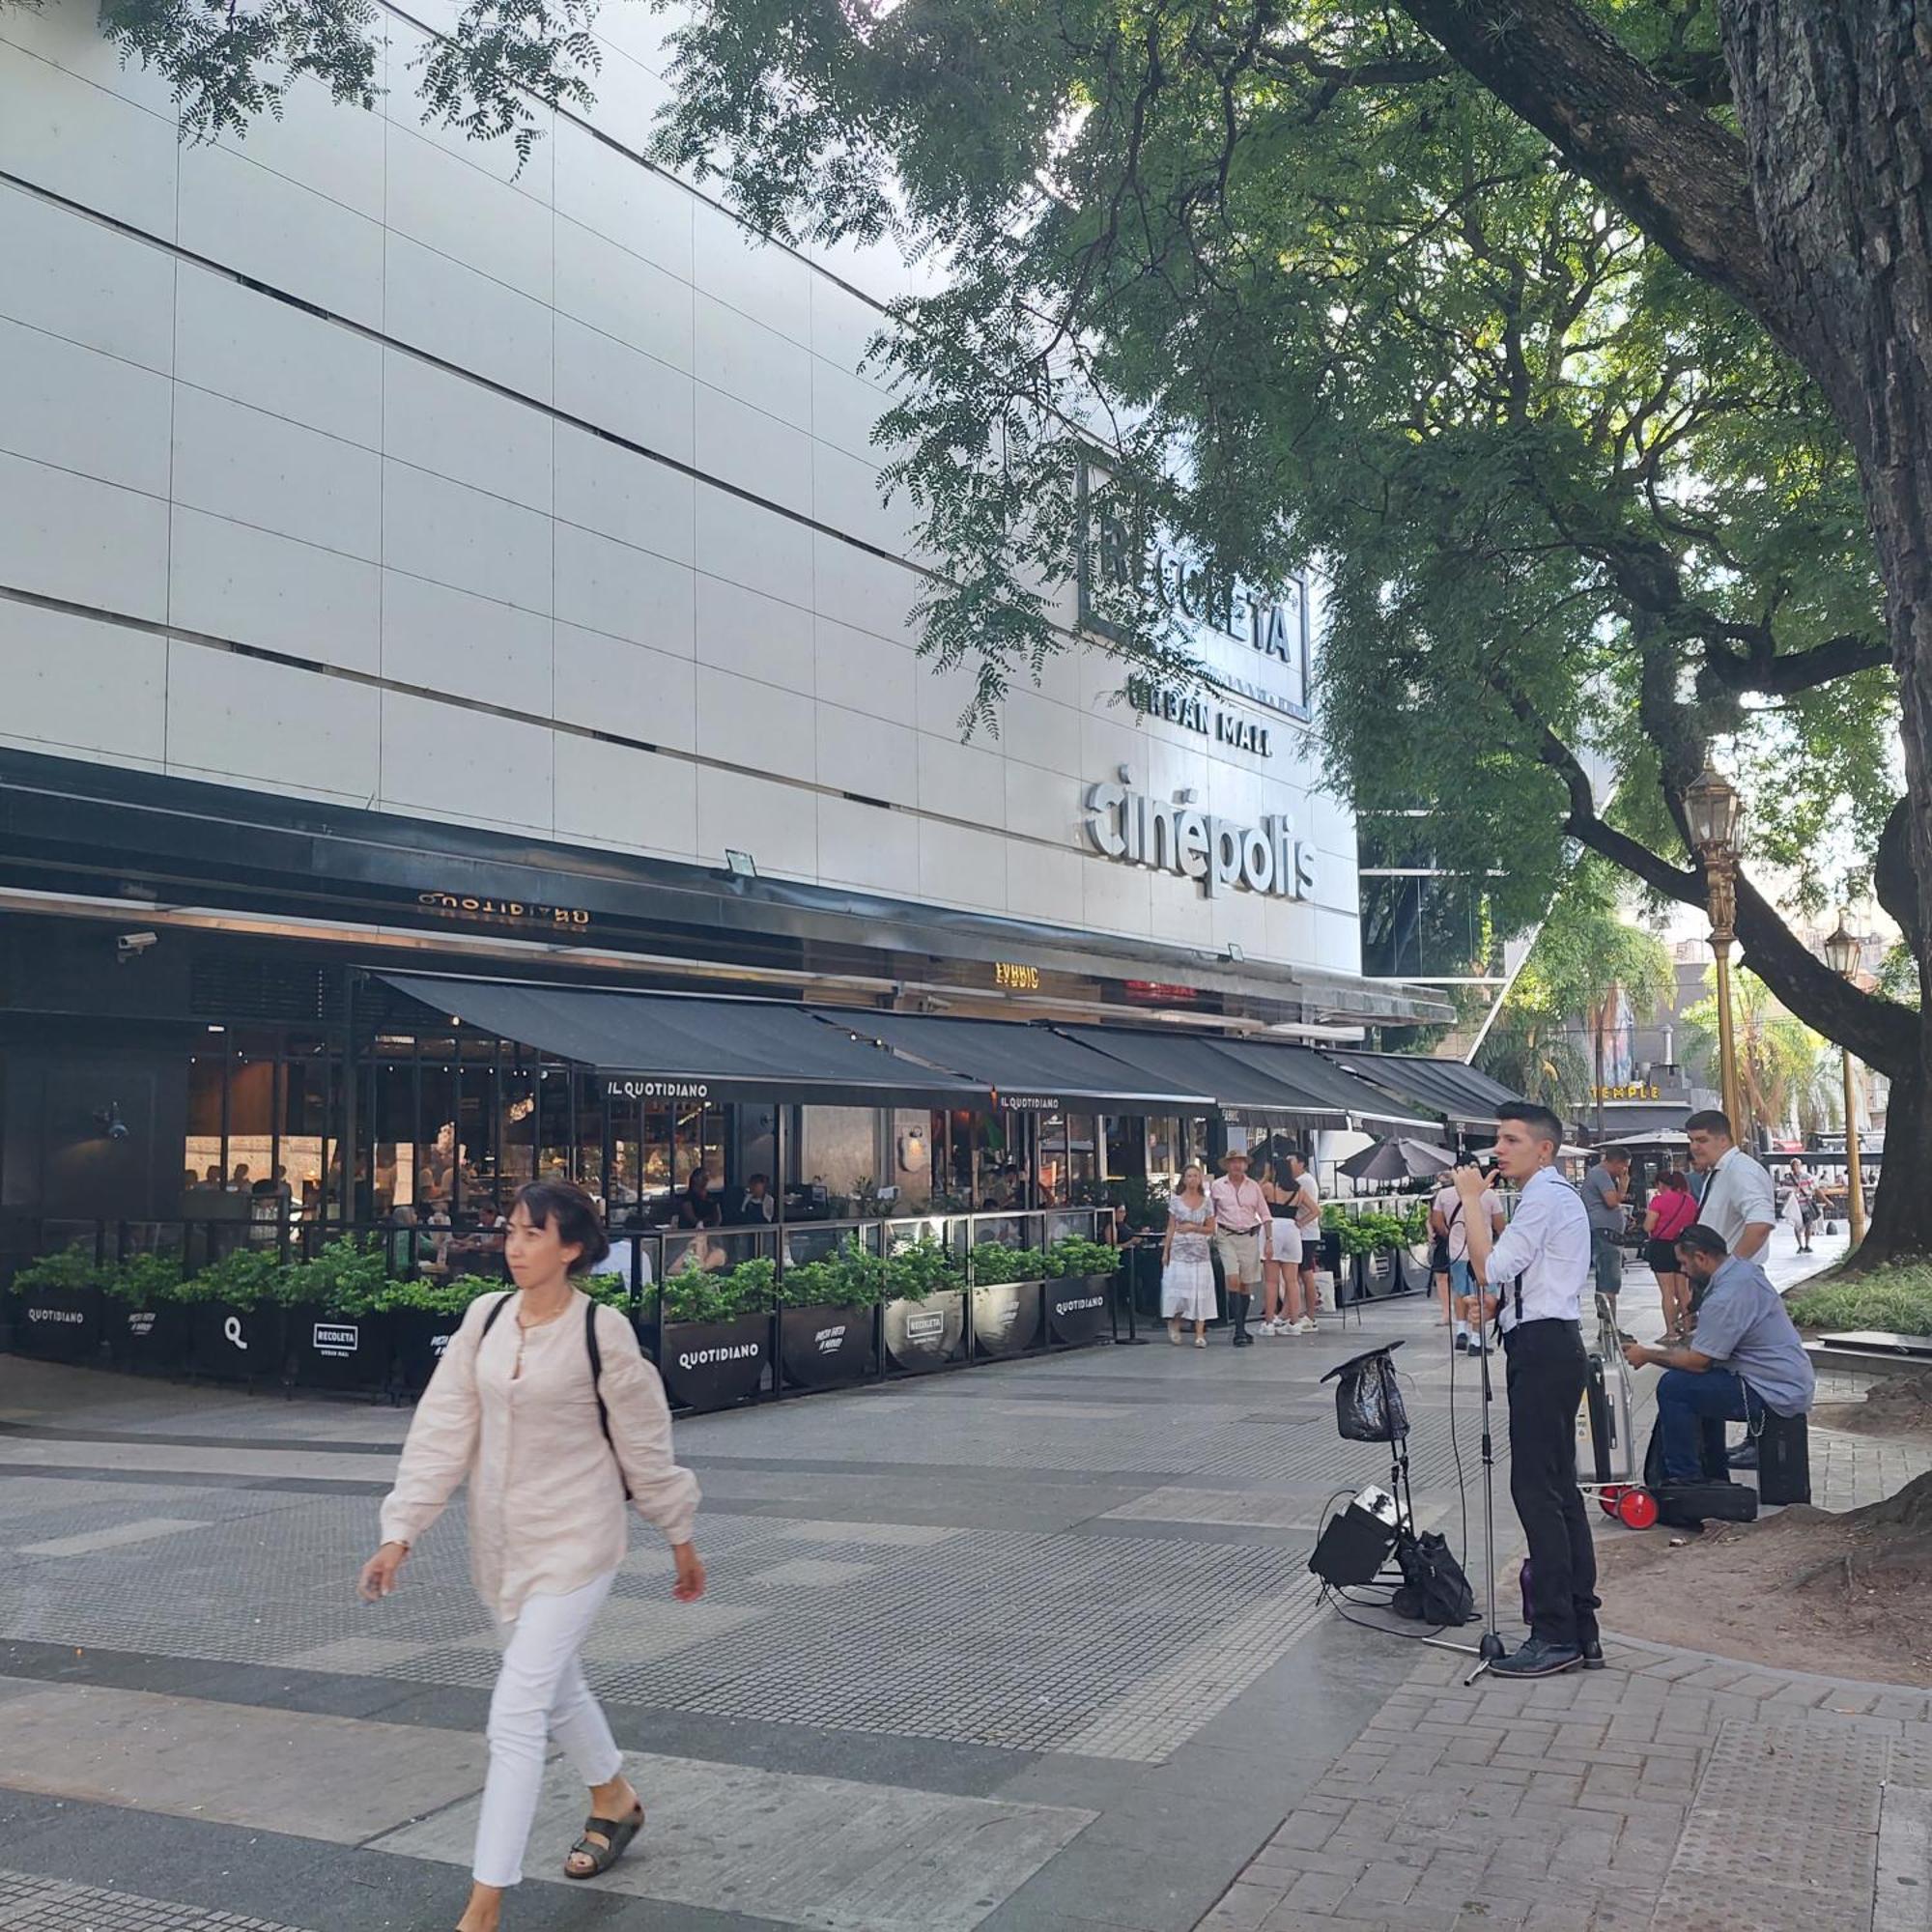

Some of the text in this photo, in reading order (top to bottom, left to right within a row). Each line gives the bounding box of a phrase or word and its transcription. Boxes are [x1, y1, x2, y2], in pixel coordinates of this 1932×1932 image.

[1216, 713, 1272, 757] MALL
[608, 1082, 707, 1098] IL QUOTIDIANO
[1590, 1084, 1660, 1099] TEMPLE
[1001, 1097, 1059, 1110] IL QUOTIDIANO
[1056, 1296, 1103, 1315] QUOTIDIANO
[28, 1308, 84, 1323] QUOTIDIANO
[224, 1317, 248, 1350] Q
[318, 1330, 355, 1343] RECOLETA
[679, 1344, 758, 1369] QUOTIDIANO
